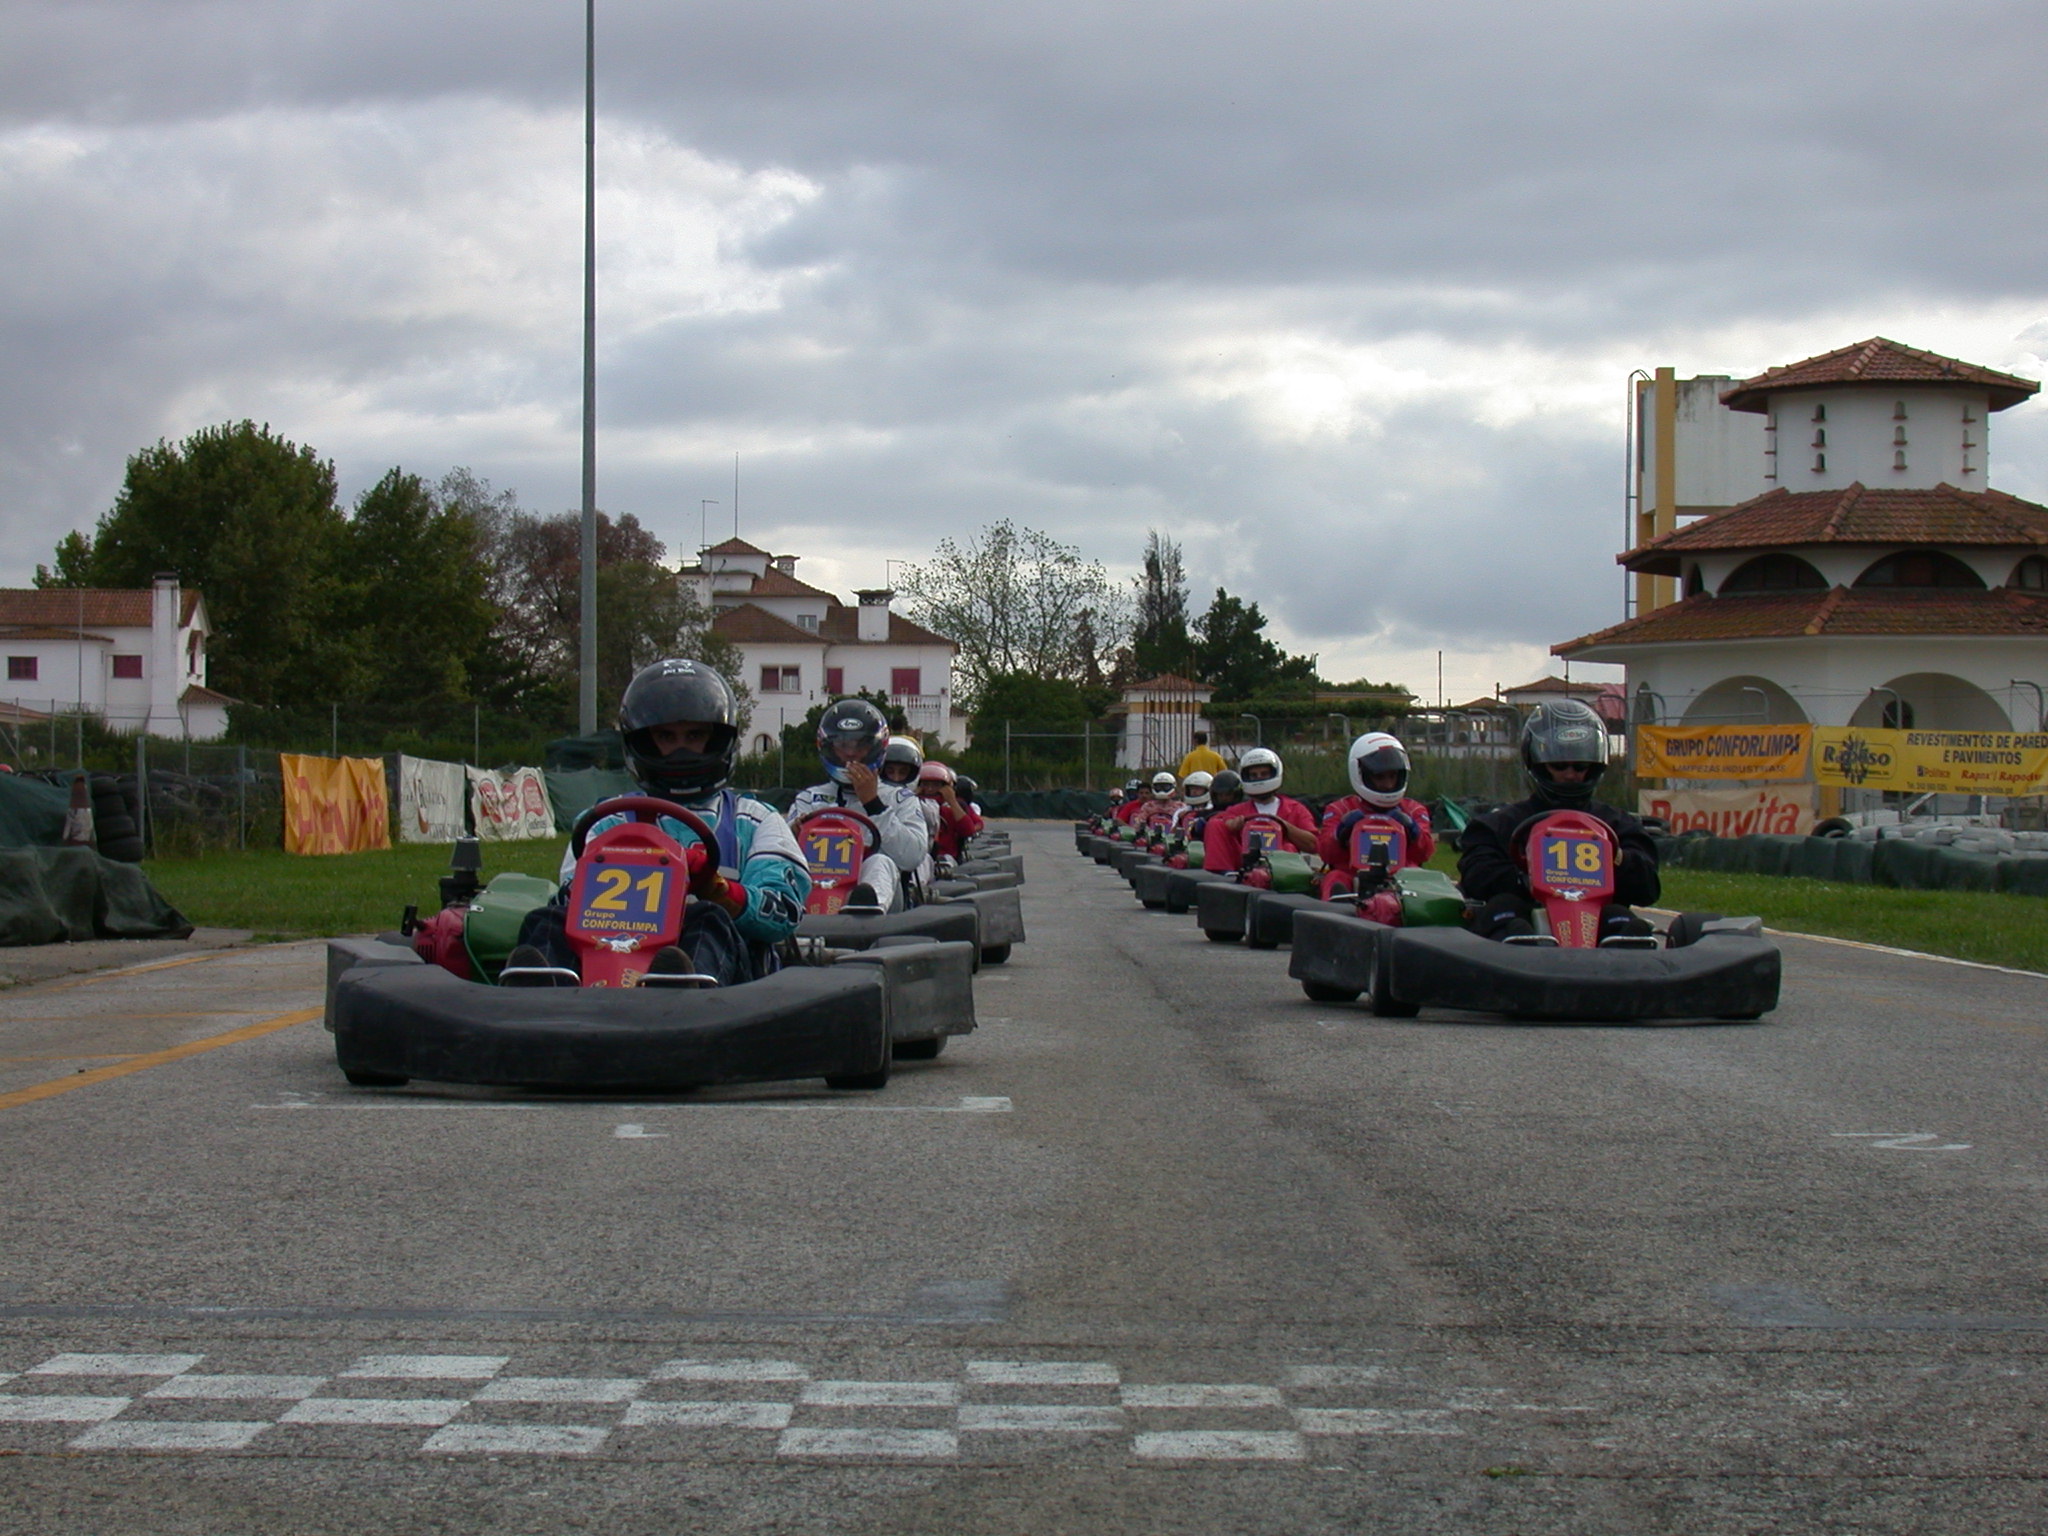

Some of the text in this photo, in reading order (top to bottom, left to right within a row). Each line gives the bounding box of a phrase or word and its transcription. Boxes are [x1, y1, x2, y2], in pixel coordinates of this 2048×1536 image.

[1666, 739, 1704, 756] GRUPO
[1907, 733, 1993, 748] REVESTIMENTOS
[1997, 735, 2012, 748] DE
[1943, 750, 2022, 765] E PAVIMENTOS
[1651, 792, 1800, 838] Pneuvita
[812, 837, 851, 863] 11
[1548, 840, 1601, 872] 18
[590, 868, 664, 912] 21
[584, 909, 615, 919] Grupo
[582, 919, 658, 933] CONFORLIMPA
